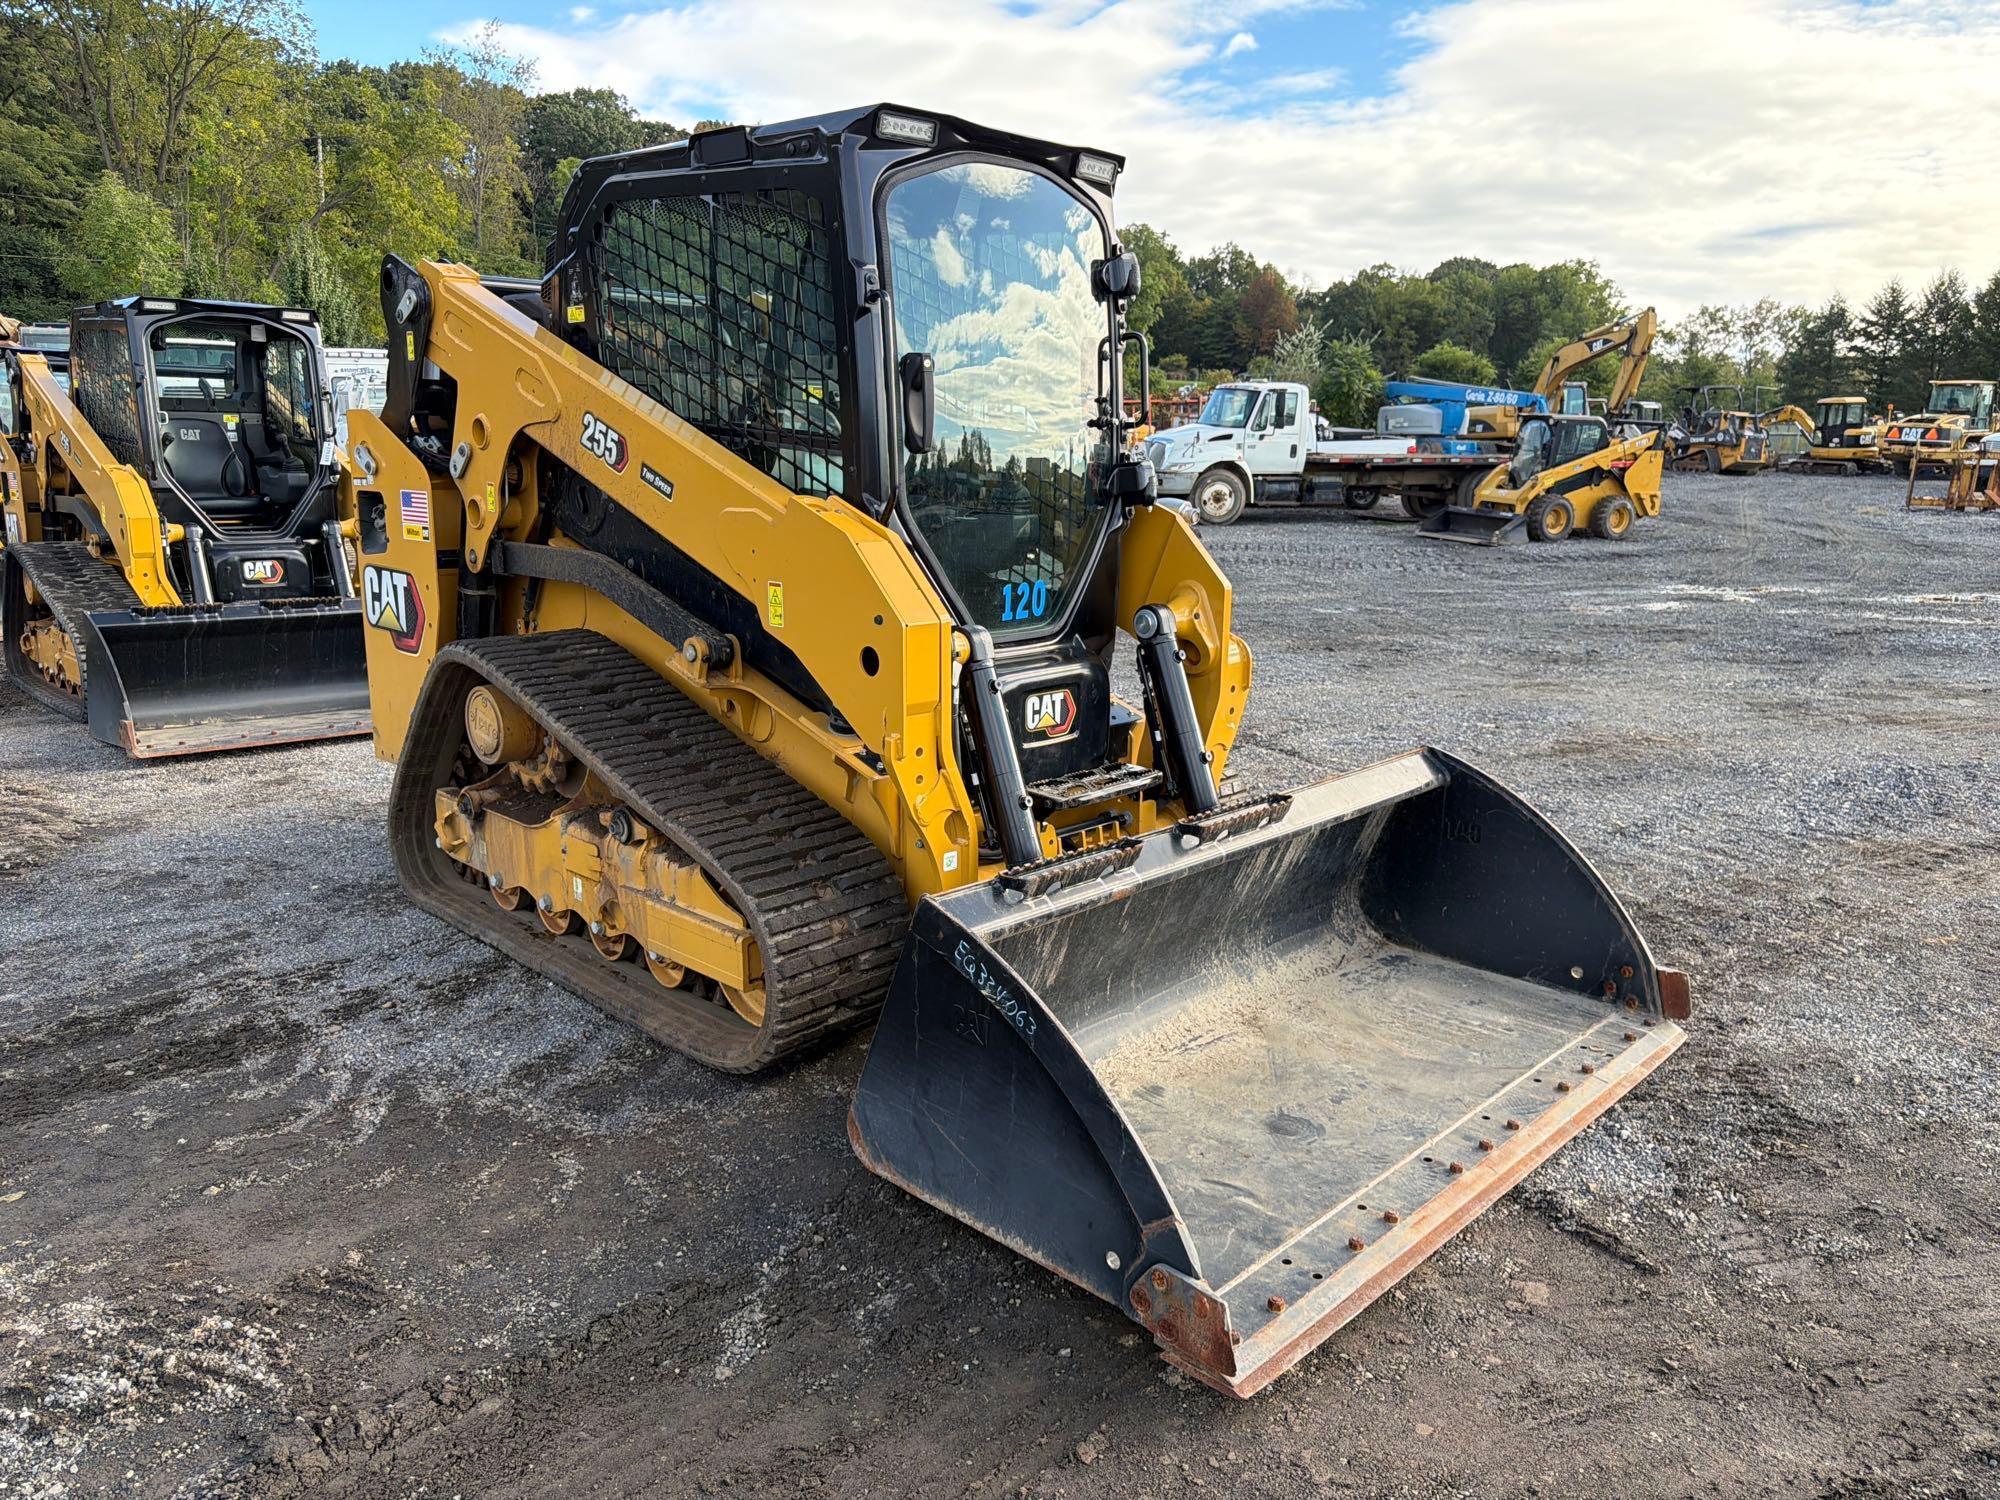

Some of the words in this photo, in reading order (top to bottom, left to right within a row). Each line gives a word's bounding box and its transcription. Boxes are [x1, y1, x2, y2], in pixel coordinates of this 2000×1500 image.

[180, 428, 201, 440] CAT
[581, 413, 619, 466] 255
[1860, 435, 1873, 445] CAT
[1901, 428, 1924, 441] CAT
[243, 561, 272, 580] CAT
[364, 566, 408, 633] CAT
[1002, 579, 1046, 621] 120
[1026, 692, 1065, 730] CAT
